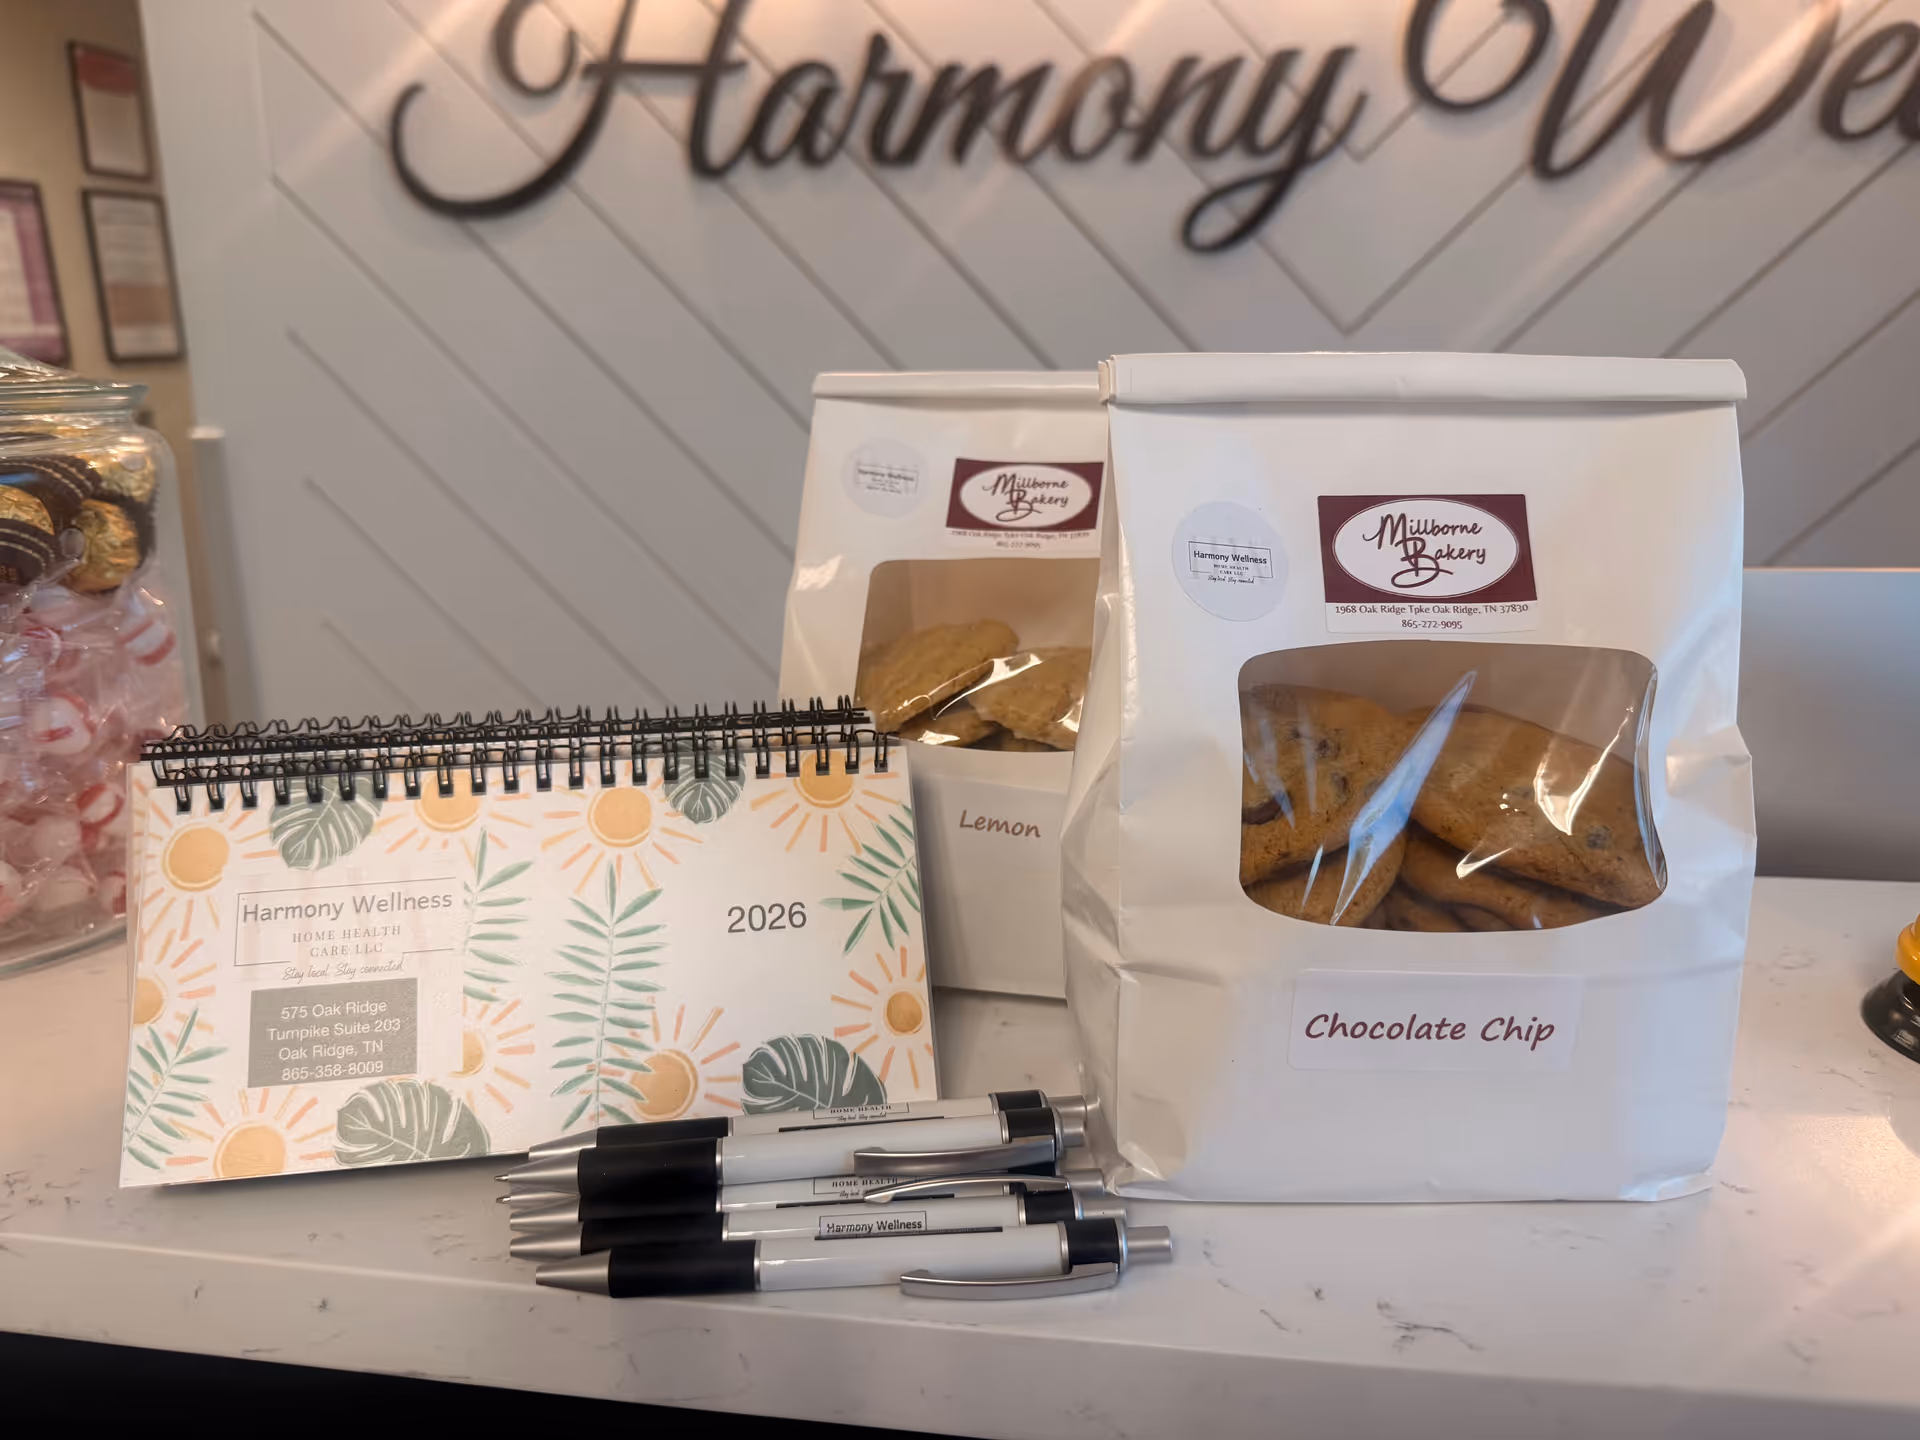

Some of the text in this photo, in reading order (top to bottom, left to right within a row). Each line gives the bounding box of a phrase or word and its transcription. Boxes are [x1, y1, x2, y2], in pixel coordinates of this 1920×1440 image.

[390, 0, 1367, 254] Harmony
[982, 473, 1068, 499] Millborne
[996, 489, 1069, 522] Bakery
[1362, 513, 1483, 555] Millborne
[1193, 550, 1268, 565] Harmony Wellness
[1391, 537, 1487, 588] Bakery
[1335, 604, 1357, 614] 1968
[1359, 604, 1378, 614] Oak
[1380, 604, 1406, 616] Ridge
[1408, 605, 1430, 615] Tpke
[1432, 604, 1450, 614] Oak
[1484, 605, 1498, 614] TN
[1499, 603, 1529, 614] 37830
[1401, 619, 1463, 630] 865-272-9095
[959, 810, 1041, 838] Lemon
[242, 891, 453, 923] Harmony Wellness
[727, 902, 807, 933] 2026
[292, 925, 401, 943] HOME HEALTH
[310, 942, 383, 958] CARE LLC
[282, 966, 304, 985] Stay
[336, 962, 357, 980] Stay
[281, 1000, 388, 1020] 575 Oak Ridge
[334, 1021, 370, 1036] Suite
[374, 1018, 401, 1032] 203
[1305, 1012, 1555, 1051] Chocolate Chip
[278, 1040, 383, 1060] Oak Ridge, TN
[281, 1060, 384, 1081] 865-358-8009
[832, 1177, 898, 1187] HOME HEALTH
[827, 1218, 922, 1234] Harmony Wellness
